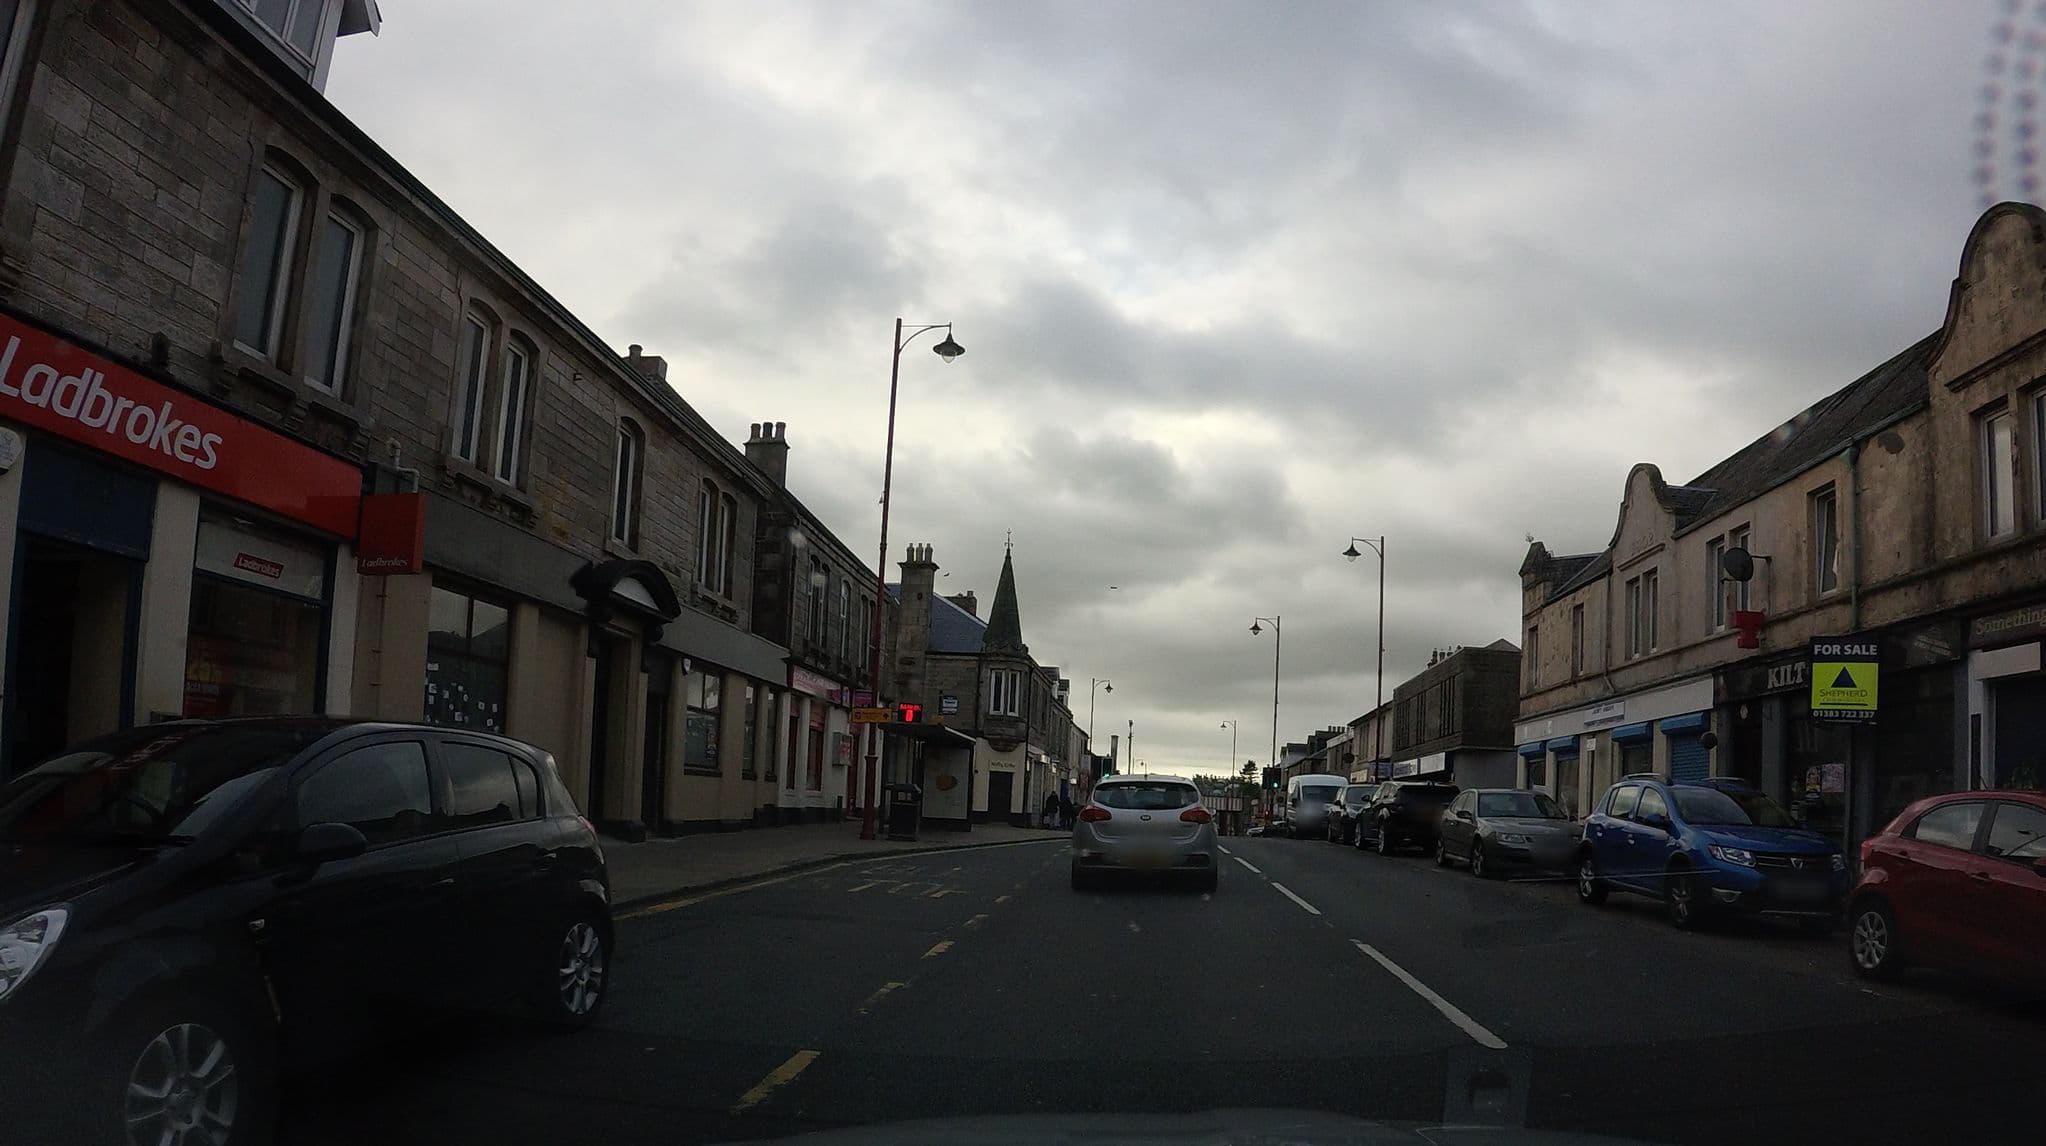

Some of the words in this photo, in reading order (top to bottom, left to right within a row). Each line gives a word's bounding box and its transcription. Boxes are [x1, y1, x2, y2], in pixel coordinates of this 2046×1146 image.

[0, 335, 224, 470] Ladbrokes
[1976, 608, 2046, 636] Something
[1813, 644, 1842, 656] FOR
[1843, 644, 1878, 656] SALE
[1767, 661, 1807, 689] KILT
